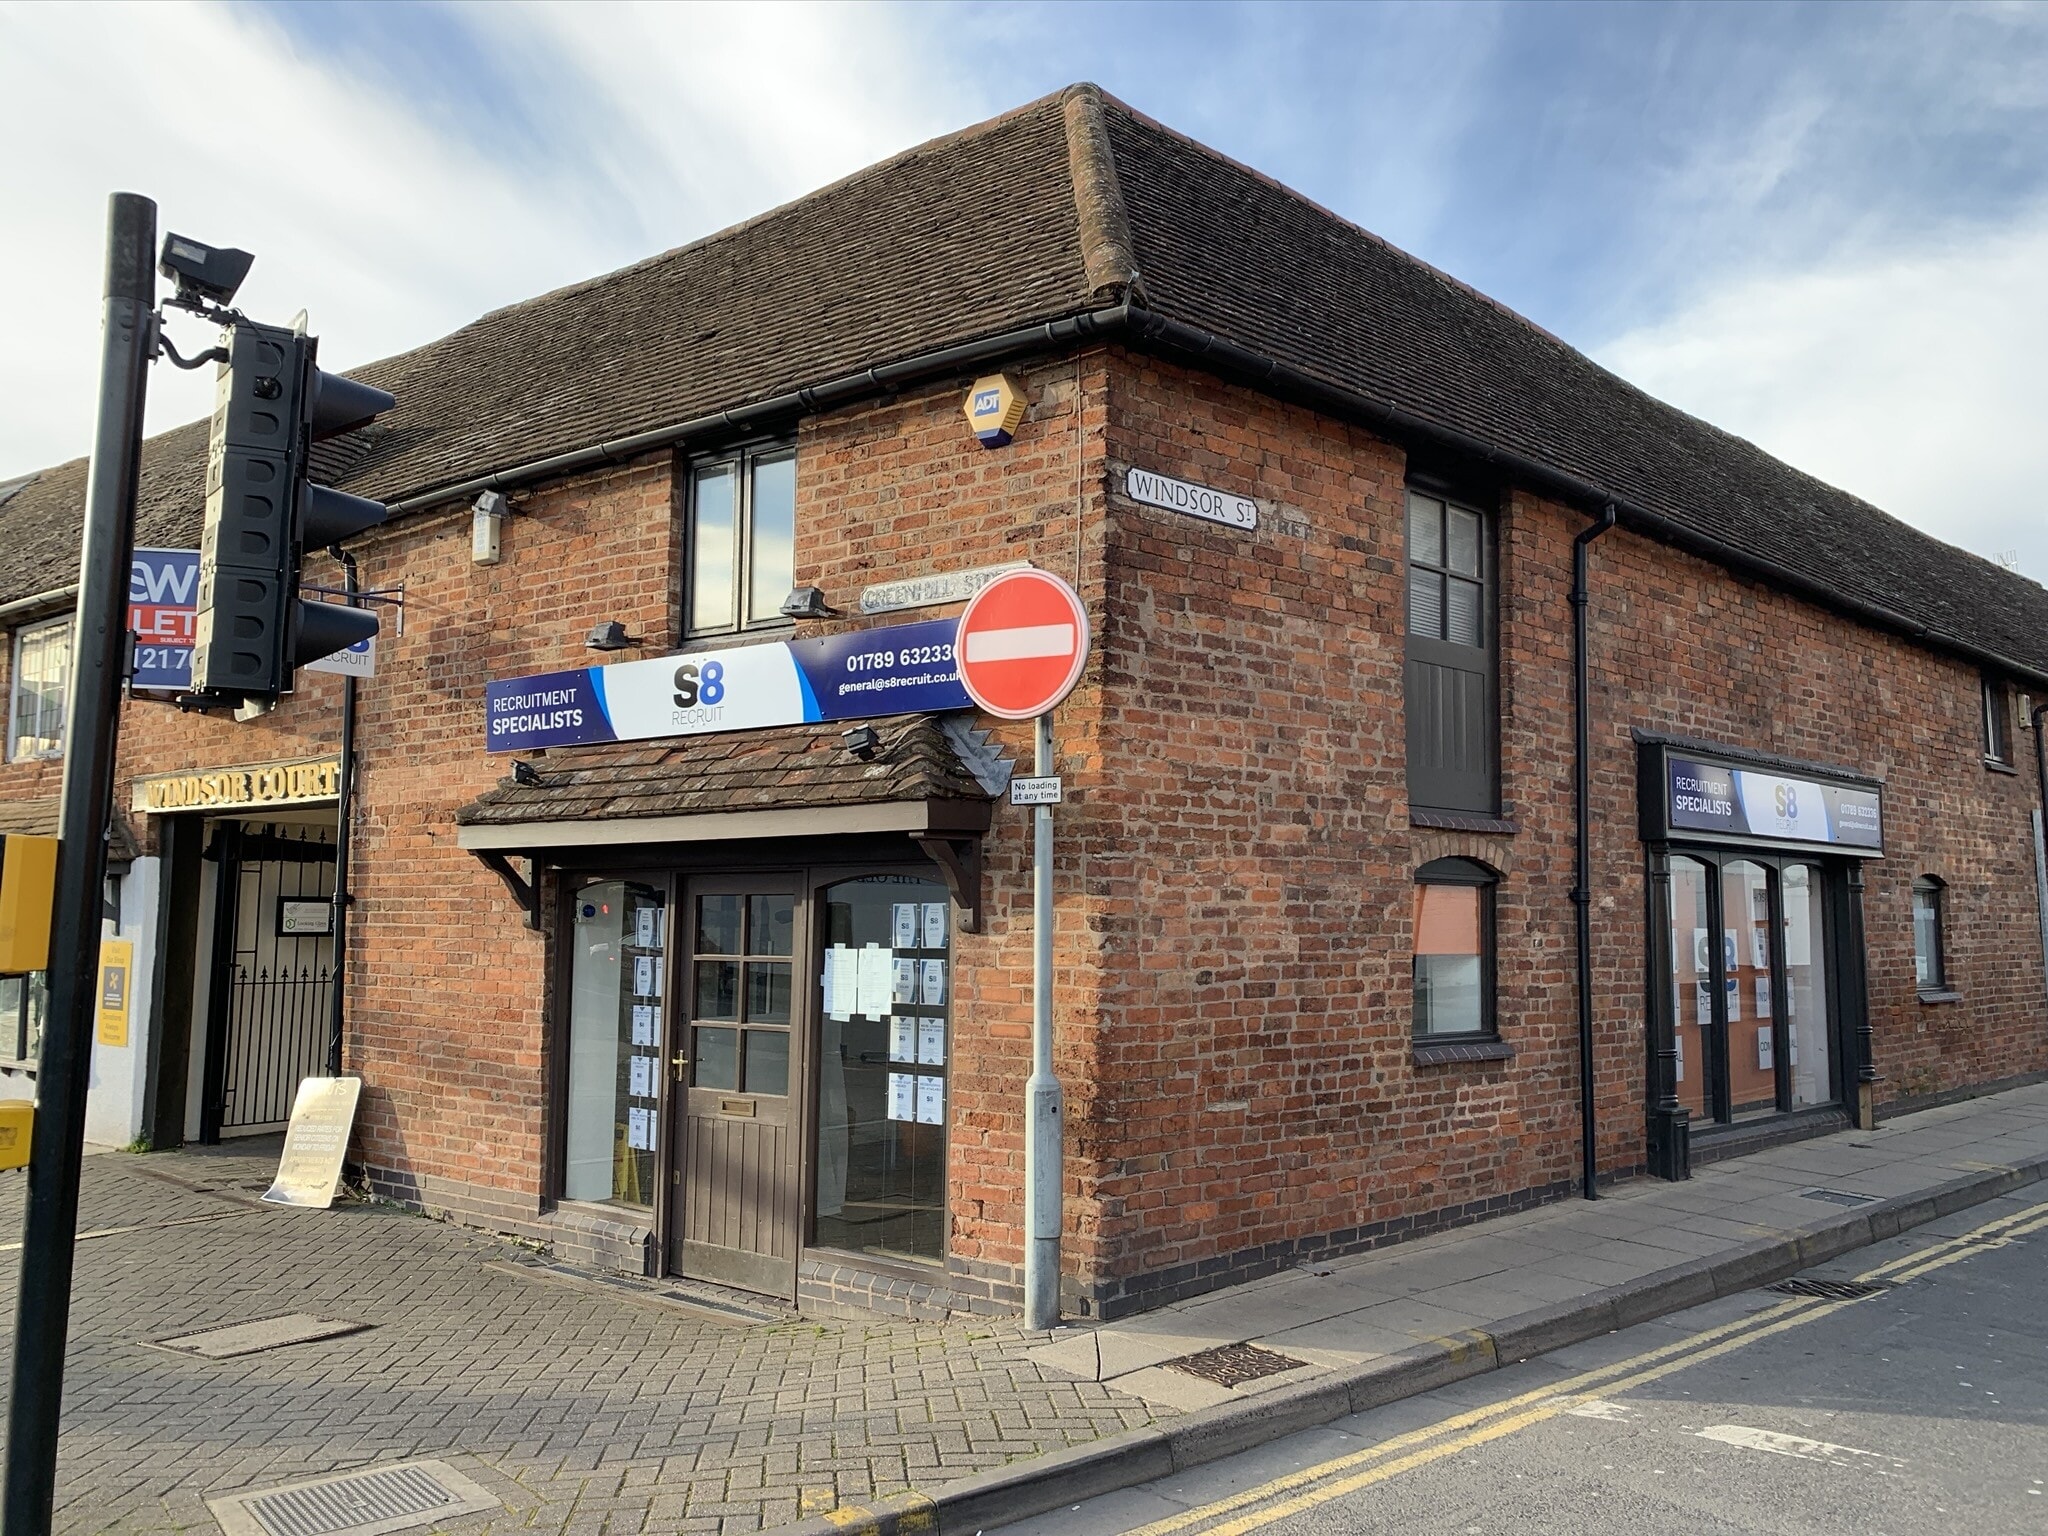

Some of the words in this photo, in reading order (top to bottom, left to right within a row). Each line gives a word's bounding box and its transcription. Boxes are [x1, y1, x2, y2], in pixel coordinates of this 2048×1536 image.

[975, 393, 999, 412] ADT
[1135, 473, 1225, 518] WINDSOR
[864, 578, 954, 608] GREENHILL
[133, 609, 197, 636] LET
[846, 650, 895, 672] 01789
[673, 660, 724, 708] S8
[493, 688, 577, 713] RECRUITMENT
[492, 709, 583, 735] SPECIALISTS
[671, 706, 724, 726] RECRUIT
[145, 771, 248, 808] WINDSOR
[250, 761, 340, 801] COURT
[1014, 782, 1026, 790] No
[1028, 781, 1057, 790] loading
[1024, 793, 1038, 801] any
[1040, 791, 1058, 799] time
[1675, 776, 1728, 796] RECRUITMENT
[1676, 795, 1732, 816] SPECIALISTS
[1775, 784, 1798, 818] S8
